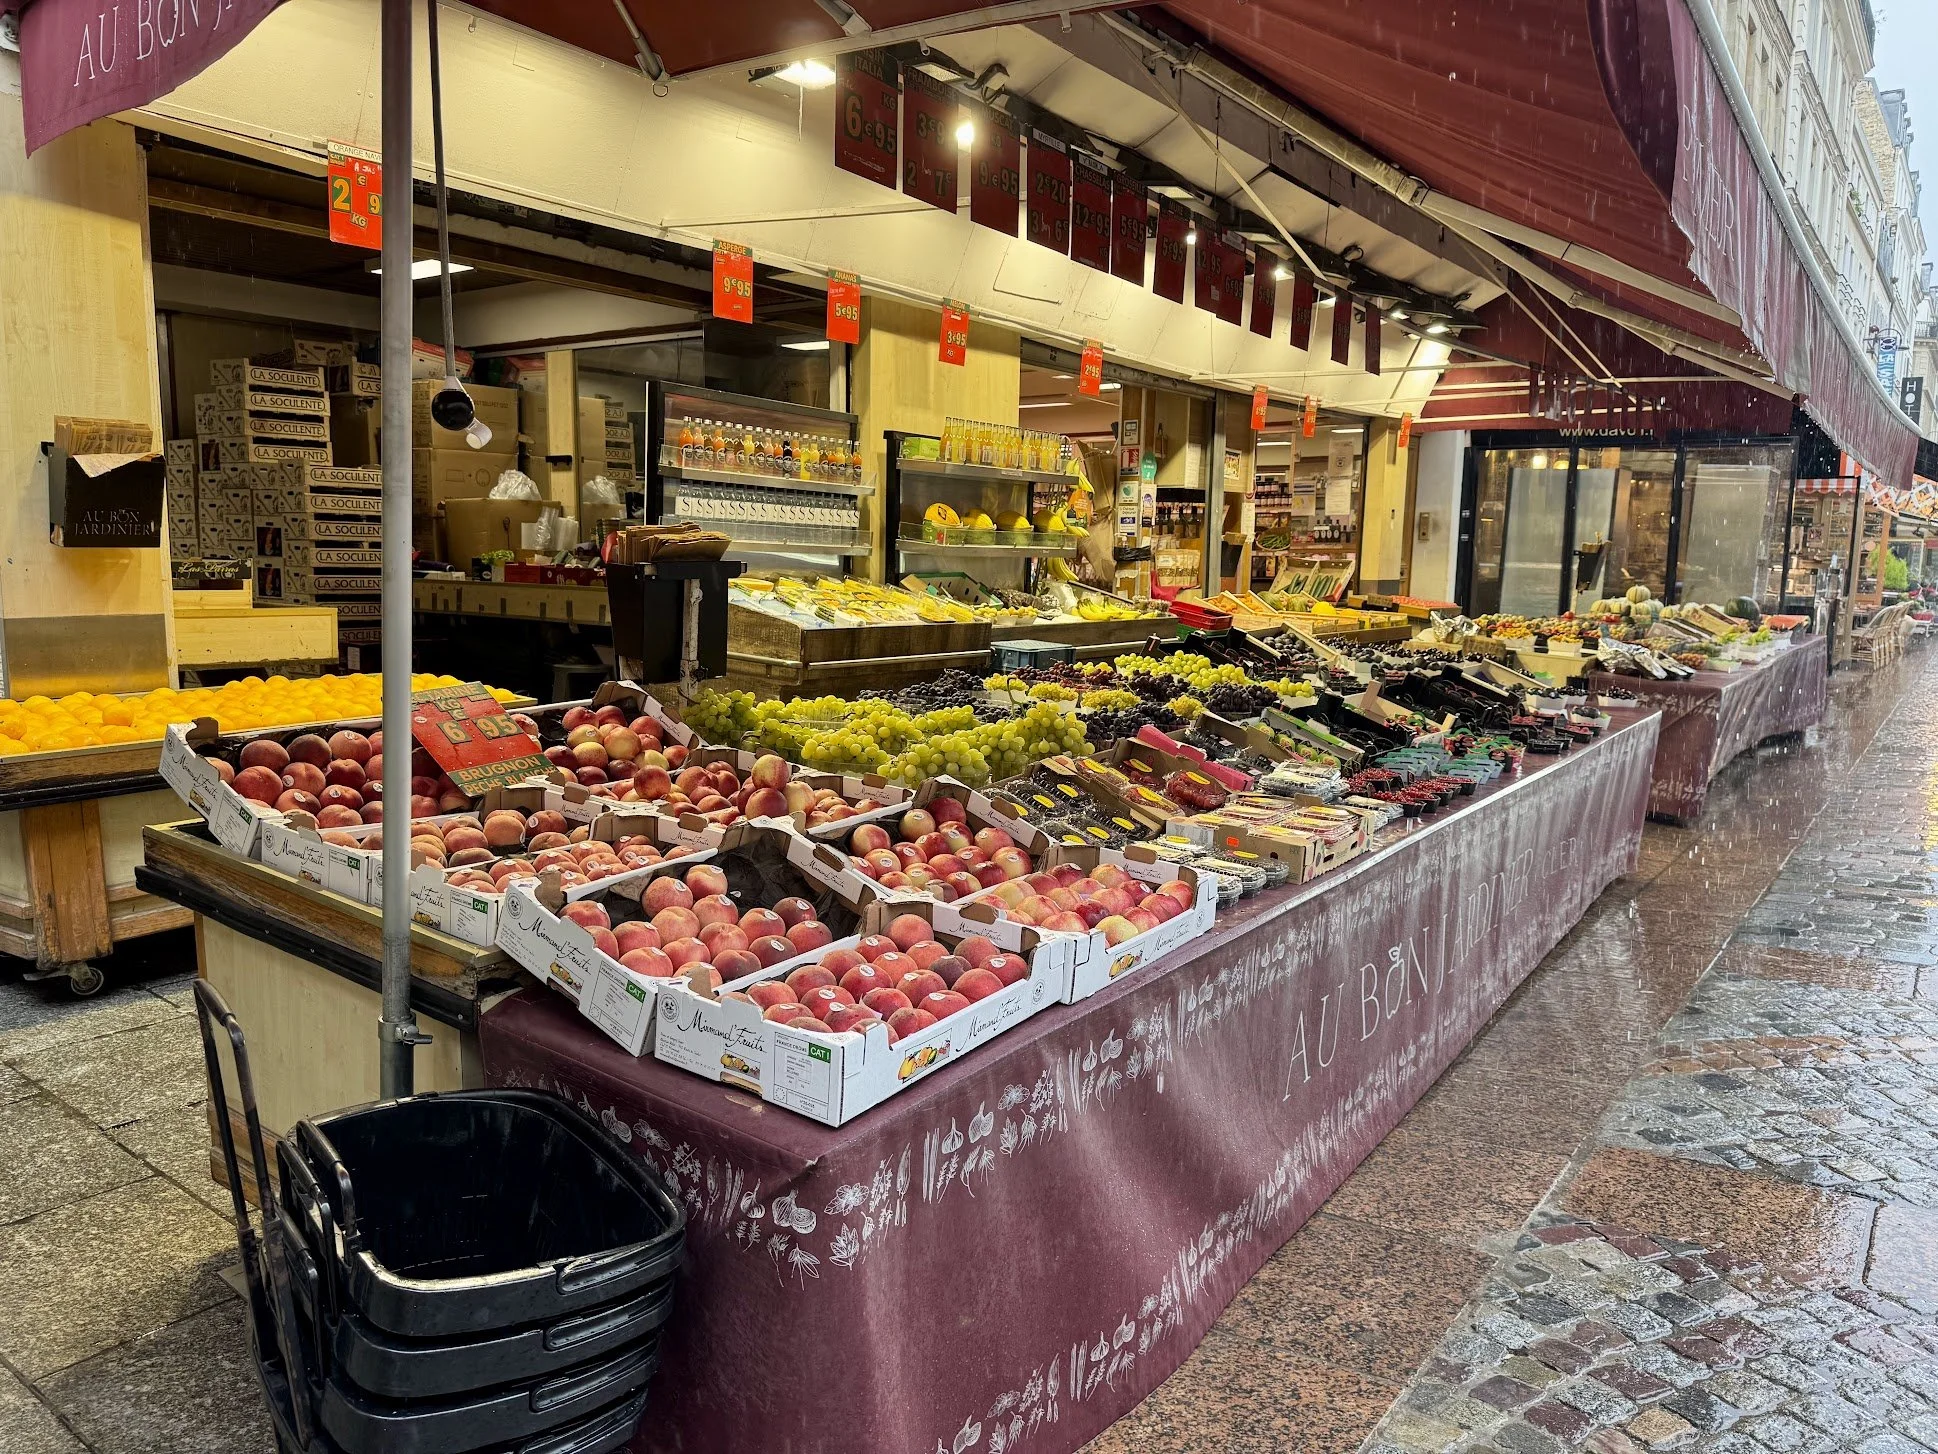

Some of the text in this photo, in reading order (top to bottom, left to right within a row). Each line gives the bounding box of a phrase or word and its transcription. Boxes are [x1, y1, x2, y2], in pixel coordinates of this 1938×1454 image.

[73, 6, 119, 87] AU
[137, 0, 200, 60] BON
[854, 55, 884, 80] ITALIA
[883, 94, 896, 109] KG
[1038, 132, 1062, 150] MYRTILLE
[333, 144, 382, 162] ORANGE NAVE
[908, 162, 916, 186] 2
[1075, 165, 1110, 189] CHASSELAS
[333, 178, 350, 211] 2
[369, 194, 380, 214] 9
[351, 213, 367, 228] KG
[718, 241, 747, 255] ASPERGE
[835, 271, 857, 283] ANANAS
[723, 276, 751, 297] 9€95
[835, 302, 858, 321] 5€95
[947, 330, 966, 347] 3€95
[253, 370, 317, 387] LA SOCULENTE
[362, 382, 373, 391] LA
[253, 395, 322, 410] LA SOCULENTE
[253, 420, 322, 436] LA SOCULENTE
[257, 447, 325, 461] LA SOCULENTE
[313, 470, 380, 483] LA SOCULENT
[314, 497, 380, 510] LA SOCULENT
[83, 509, 140, 523] AU BON
[74, 523, 151, 537] JARDINIER
[318, 525, 380, 536] LA SOCULEN
[320, 552, 381, 562] LA SOCULEN
[317, 578, 380, 589] LA SOCULEN
[337, 605, 380, 615] SOCULEN
[437, 699, 462, 710] KG
[443, 714, 519, 741] 6 95
[460, 757, 542, 782] BRUGNON
[473, 902, 484, 912] CAT
[628, 984, 641, 997] CAT
[1283, 982, 1345, 1102] AU
[1359, 927, 1430, 1042] BON
[810, 1047, 826, 1058] CAT
